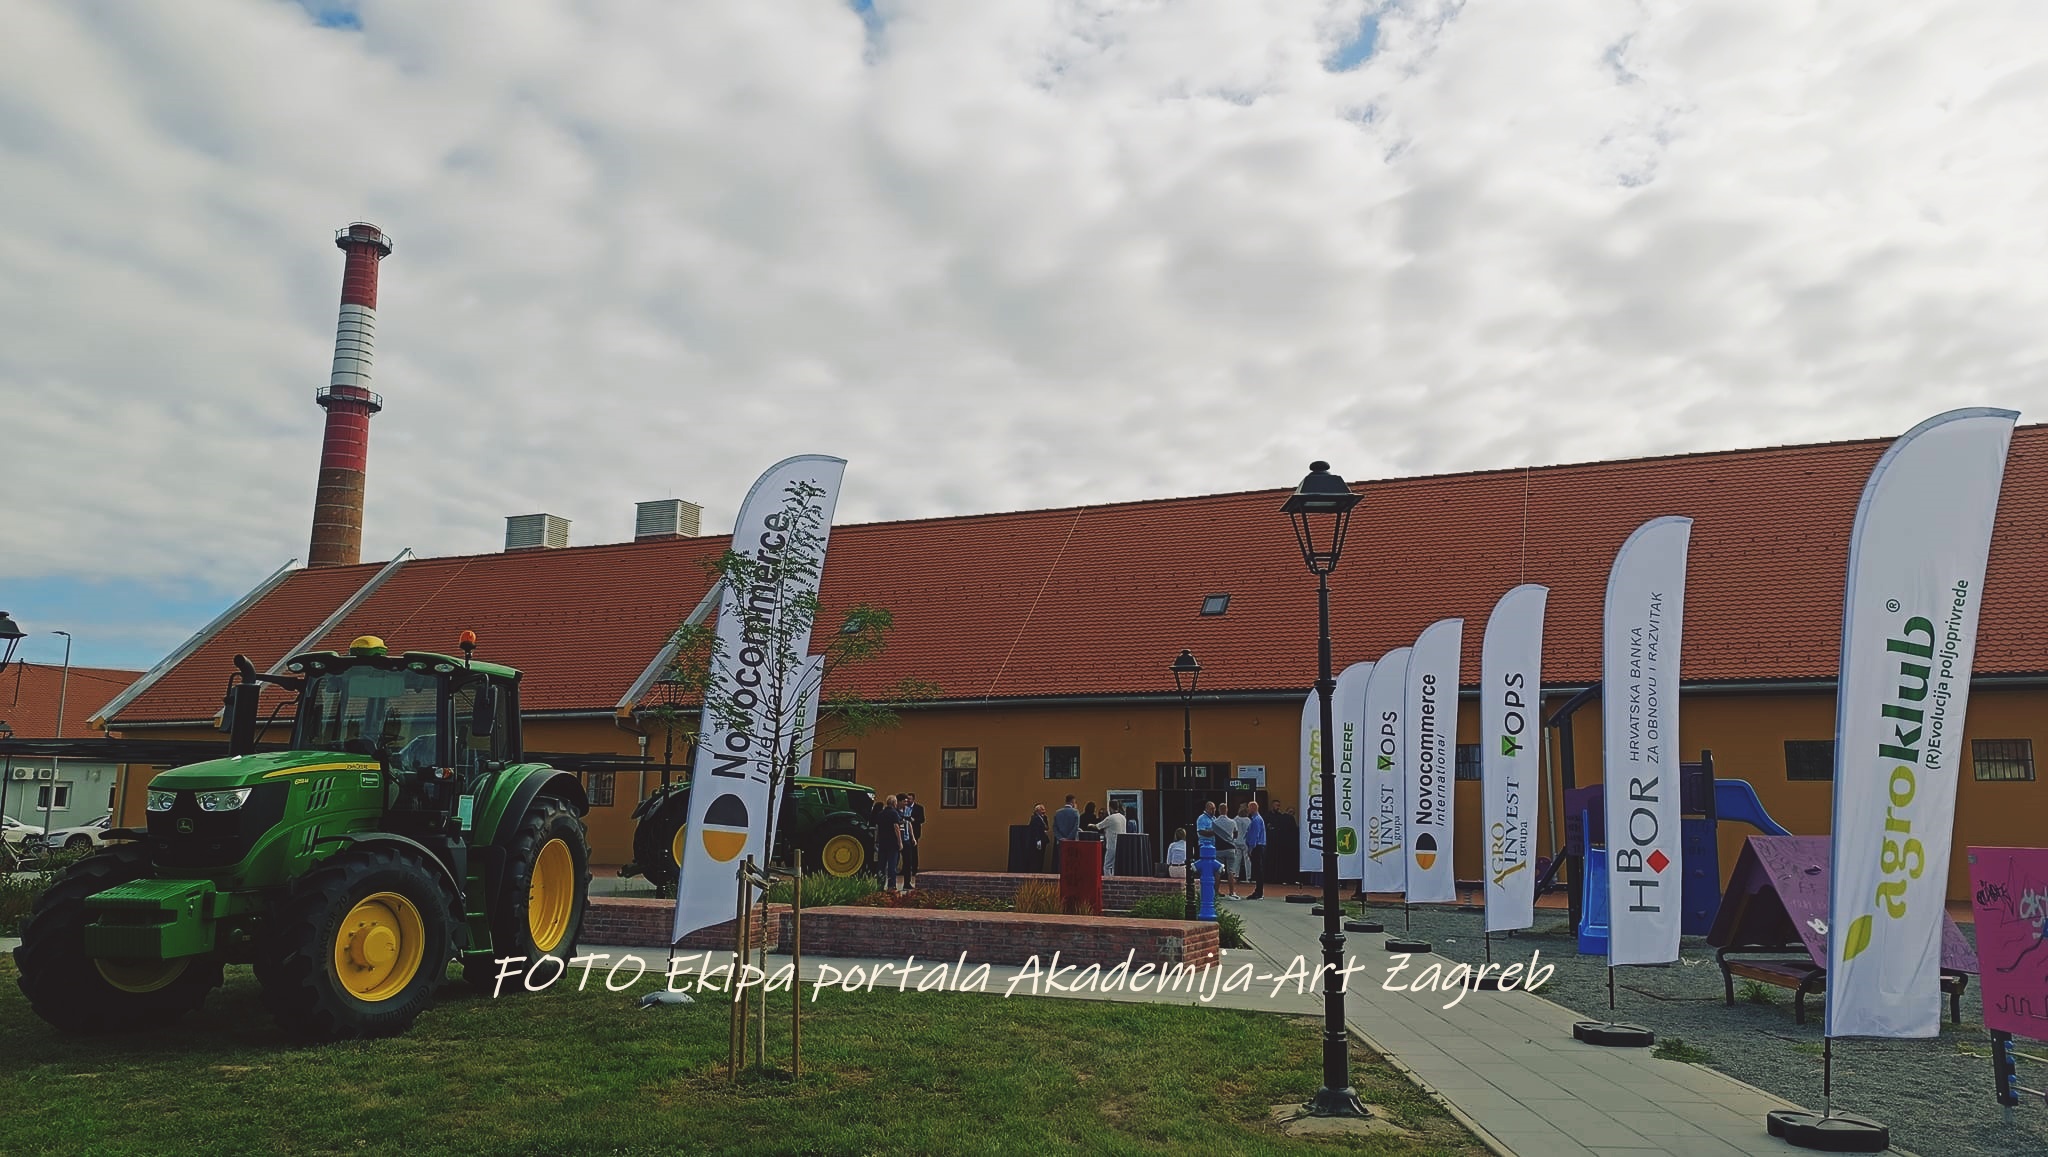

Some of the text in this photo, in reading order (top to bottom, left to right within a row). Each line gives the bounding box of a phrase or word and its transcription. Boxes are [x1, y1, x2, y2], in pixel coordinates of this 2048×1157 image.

[1648, 591, 1663, 662] RAZVITAK
[1503, 672, 1525, 756] YOPS
[1630, 627, 1642, 762] HRVATSKA BANKA
[1647, 677, 1659, 740] OBNOVU
[1926, 580, 1969, 770] (R)Evolucija poljoprivrede
[1340, 722, 1354, 821] JOHN DEERE
[1378, 711, 1397, 770] YOPS
[1416, 674, 1436, 825] Novocommerce
[1436, 734, 1446, 827] International
[1647, 745, 1659, 764] ZA
[1876, 616, 1935, 919] agroklub
[1368, 816, 1401, 865] AGRO
[1381, 784, 1394, 845] INVEST
[1492, 822, 1526, 891] AGRO
[1505, 776, 1520, 864] INVEST
[1519, 821, 1529, 857] grupa
[1616, 776, 1660, 912] HBOR
